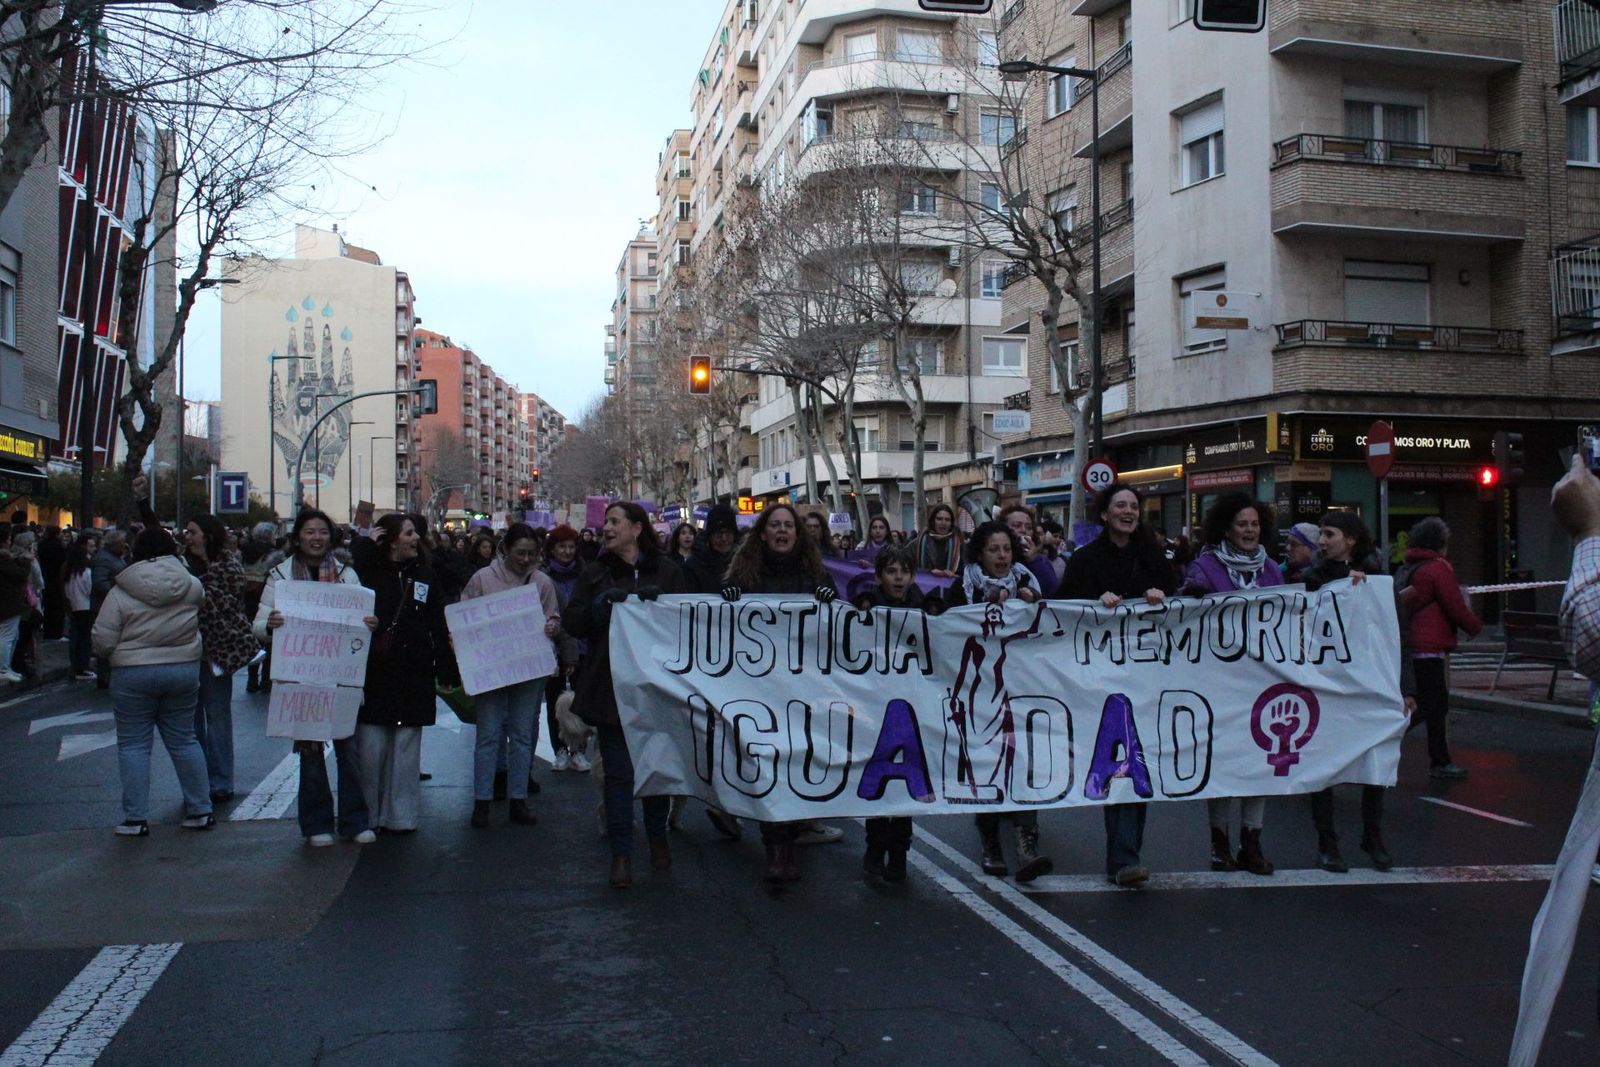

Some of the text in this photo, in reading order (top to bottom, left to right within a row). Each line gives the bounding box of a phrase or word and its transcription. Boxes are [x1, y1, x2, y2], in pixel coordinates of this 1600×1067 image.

[1310, 443, 1334, 452] ORO
[1416, 437, 1434, 448] ORO
[1435, 438, 1443, 448] Y
[1443, 438, 1471, 449] PLATA
[1090, 471, 1110, 483] 30
[224, 480, 243, 504] T
[1298, 505, 1322, 513] ORO
[455, 606, 481, 625] TE
[663, 600, 934, 678] JUSTICIA
[1074, 590, 1352, 666] MEMORIA
[281, 632, 342, 659] LUCHAN
[279, 686, 337, 724] MUEREN
[687, 689, 1213, 804] IGUALDAD
